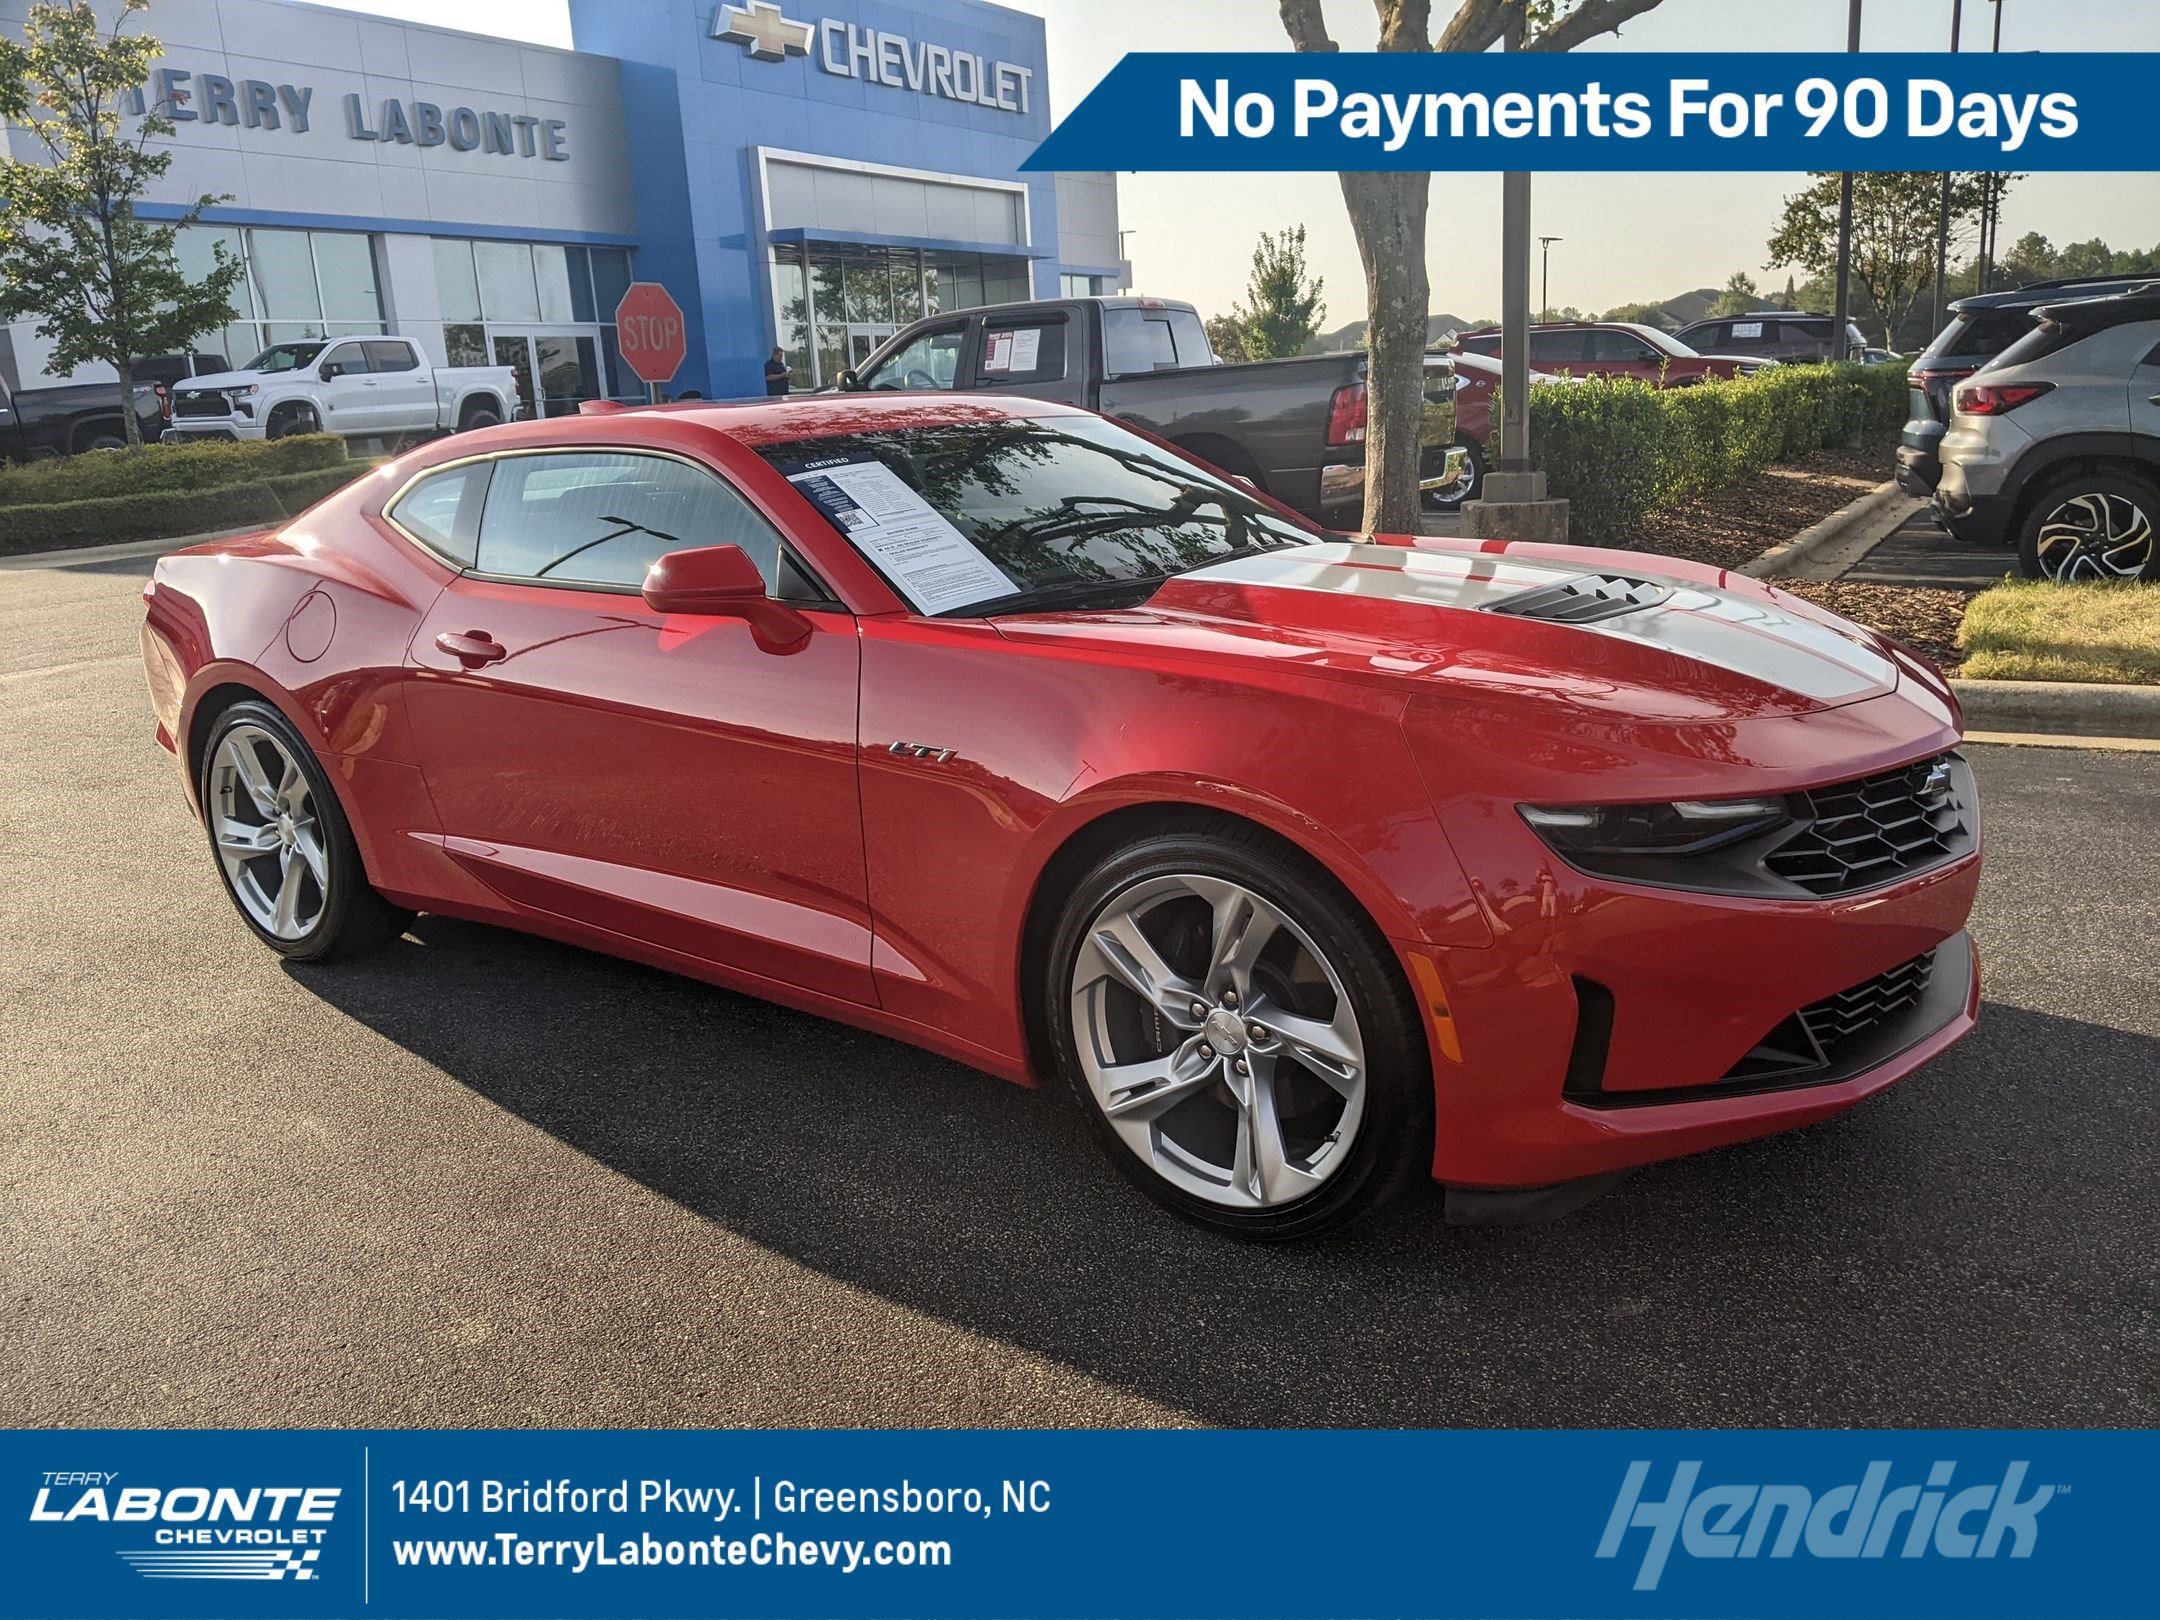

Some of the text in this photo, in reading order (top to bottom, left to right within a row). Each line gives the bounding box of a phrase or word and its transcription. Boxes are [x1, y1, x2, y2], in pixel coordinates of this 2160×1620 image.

[818, 17, 1032, 114] CHEVROLET
[344, 92, 570, 162] LABONTE
[623, 315, 678, 351] STOP
[804, 457, 849, 469] CERTIFIED
[889, 741, 959, 763] LT1
